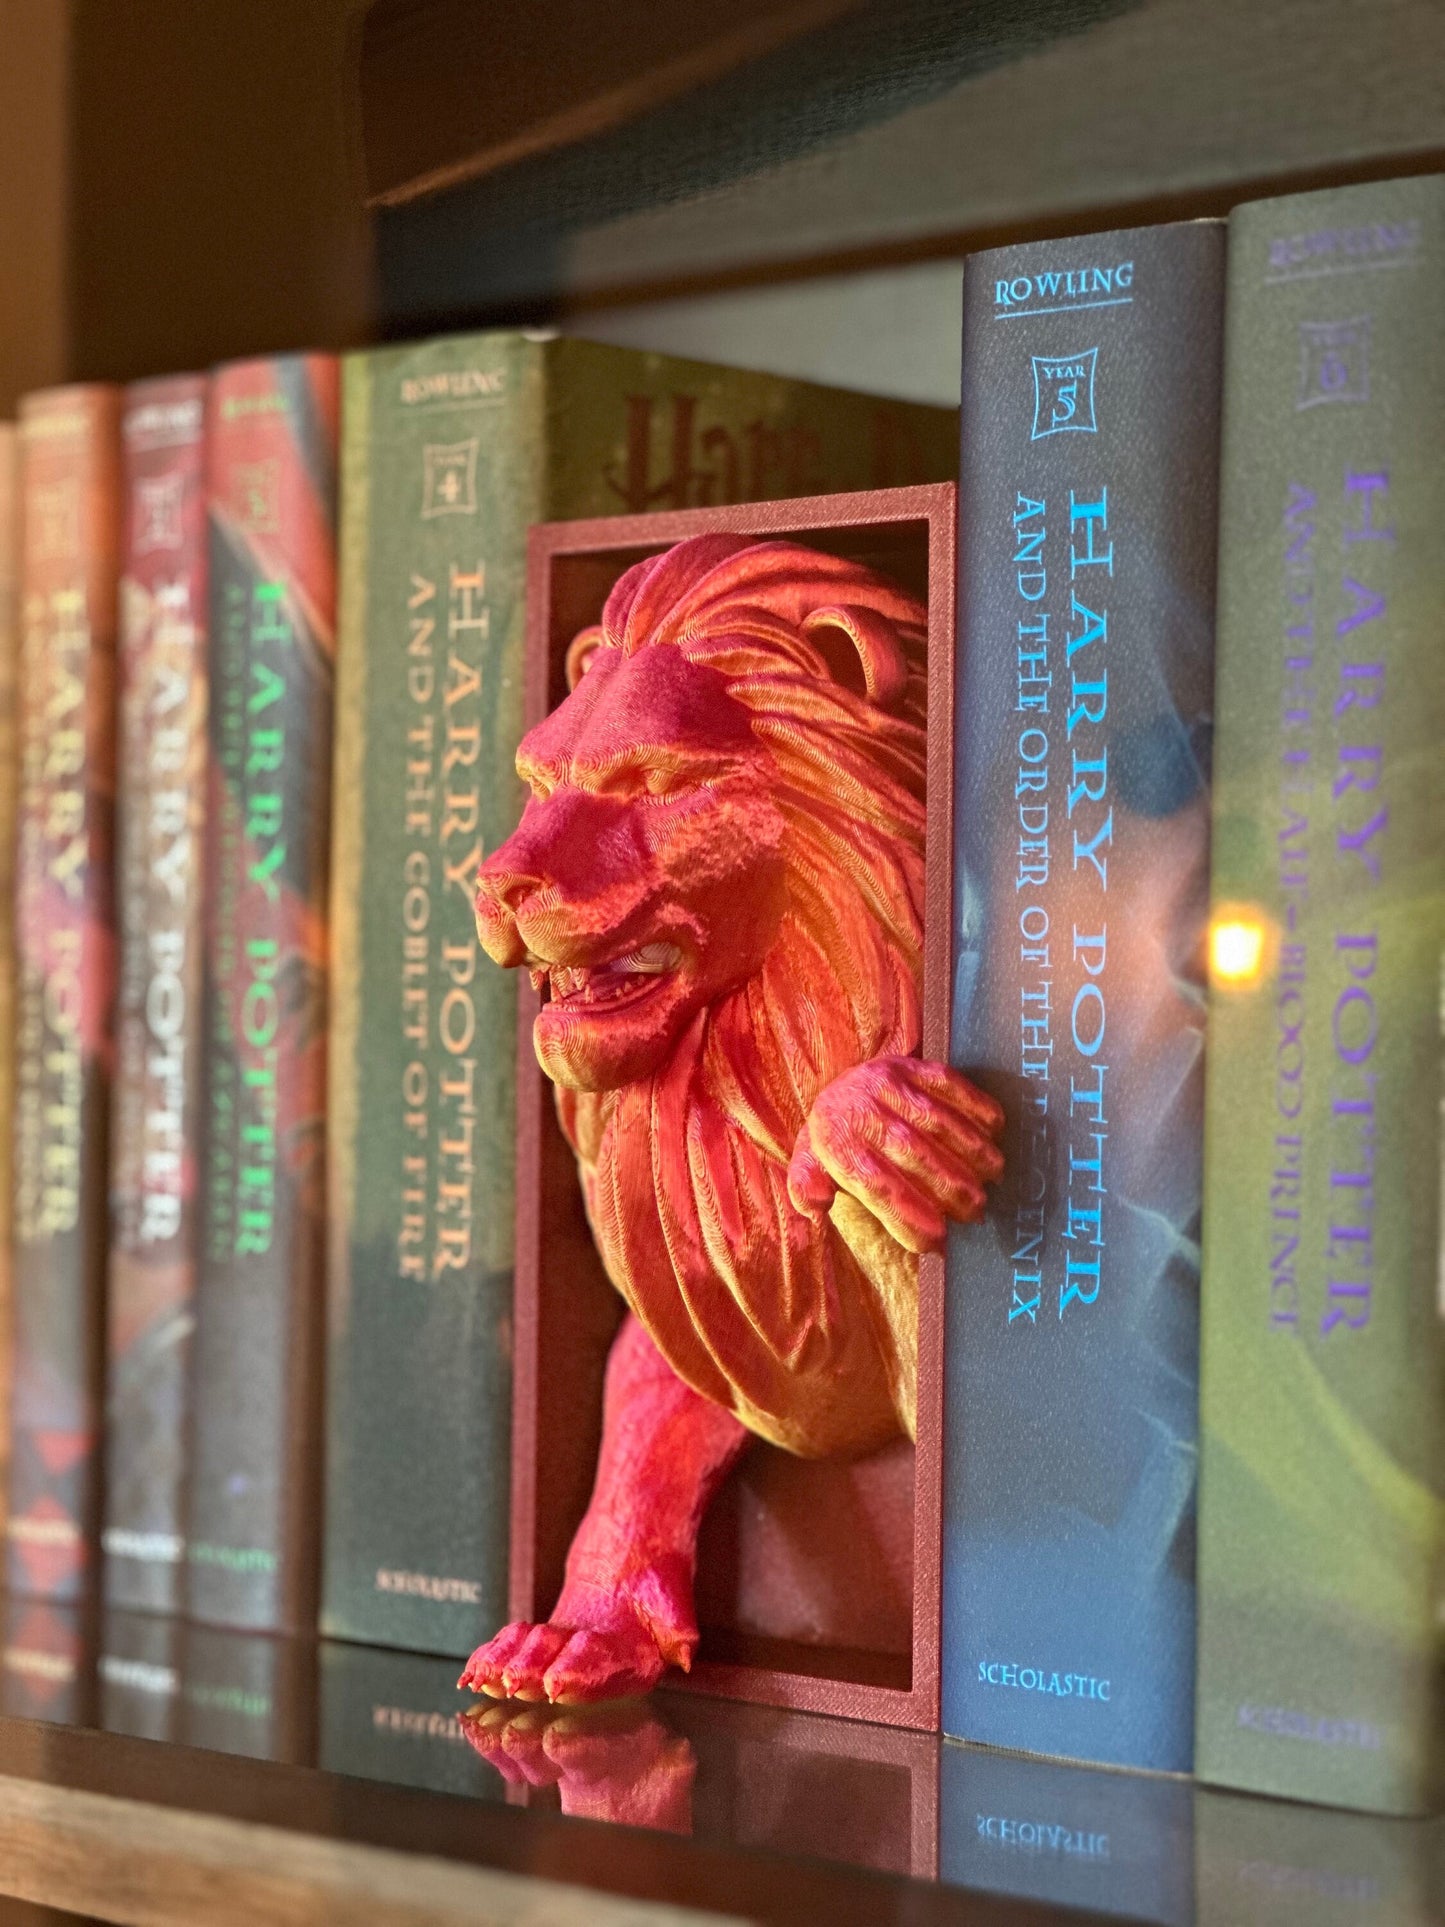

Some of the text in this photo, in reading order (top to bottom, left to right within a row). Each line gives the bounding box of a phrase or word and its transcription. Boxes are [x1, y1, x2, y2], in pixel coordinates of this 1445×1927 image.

[995, 260, 1134, 305] ROWLING
[1043, 365, 1086, 379] YEAR
[1052, 380, 1077, 427] 5
[1013, 491, 1047, 601] AND
[1283, 482, 1316, 605] AND
[1015, 612, 1051, 713] THE
[1281, 613, 1315, 735] THE
[1015, 729, 1052, 894] ORDER
[234, 579, 288, 1258] HARRY POTTER
[397, 569, 437, 1283] AND THE GOBLET OF FIRE
[432, 560, 490, 1287] HARRY POTTER
[1019, 905, 1050, 969] OF
[1058, 487, 1113, 1320] HARRY POTTER
[1320, 467, 1396, 1338] HARRY POTTER
[140, 928, 186, 1241] POTTER
[1020, 981, 1053, 1081] THE
[1268, 1134, 1302, 1334] PRINCE
[978, 1661, 1111, 1701] SCHOLASTIC
